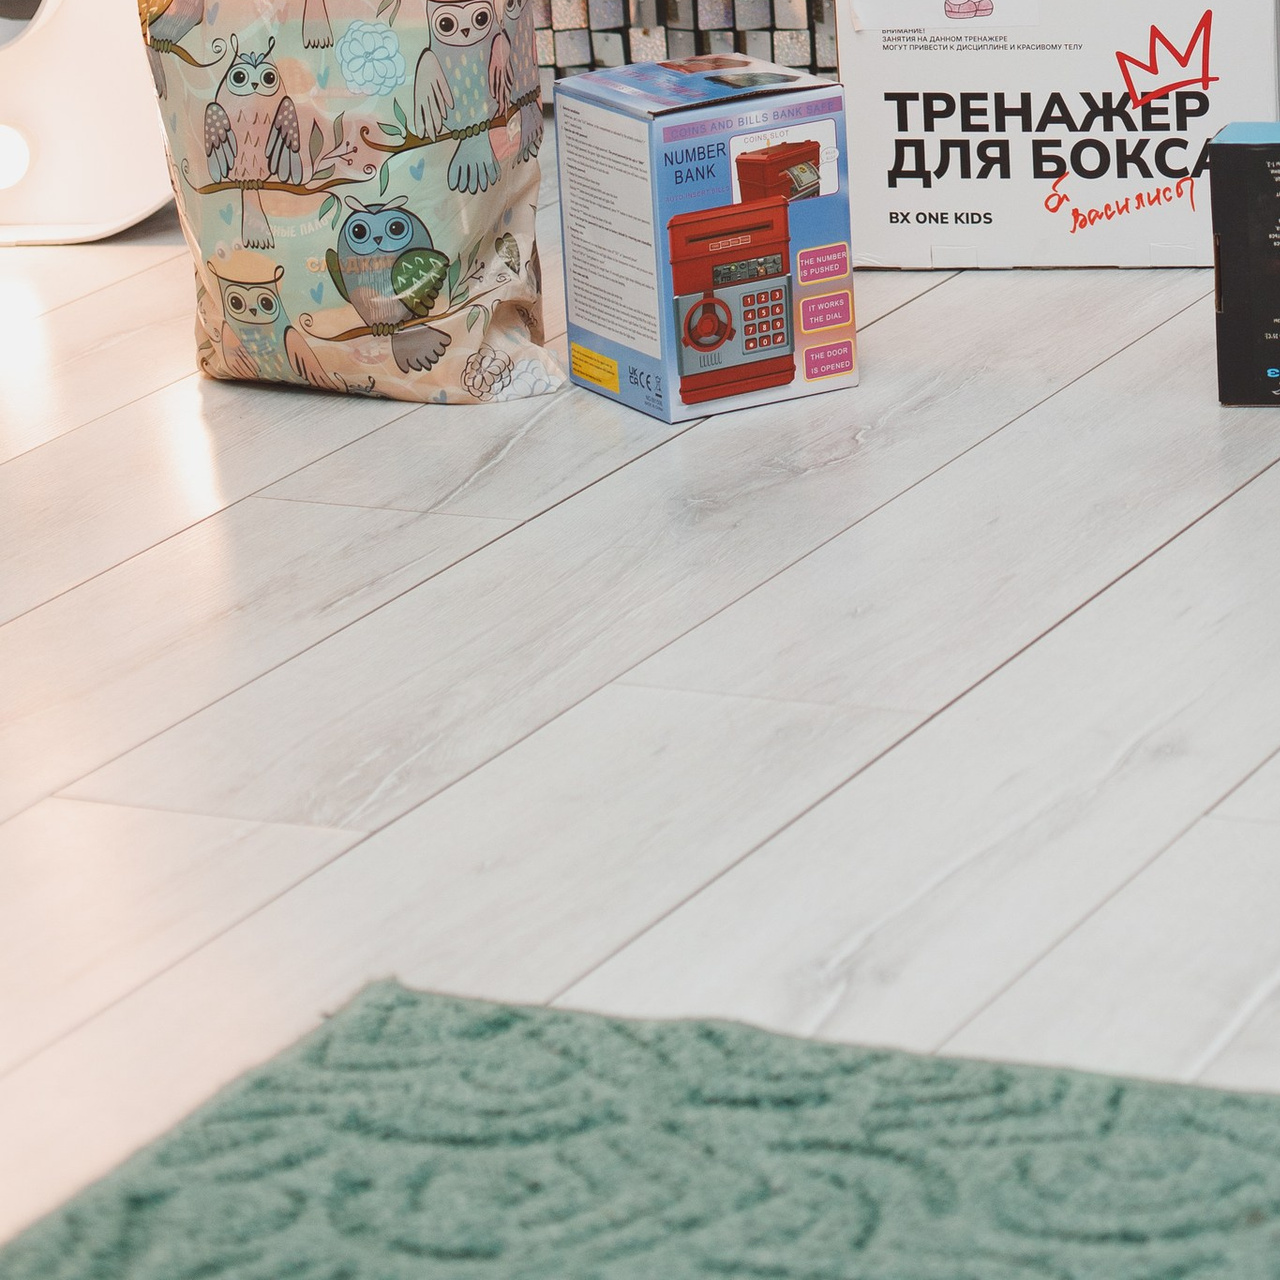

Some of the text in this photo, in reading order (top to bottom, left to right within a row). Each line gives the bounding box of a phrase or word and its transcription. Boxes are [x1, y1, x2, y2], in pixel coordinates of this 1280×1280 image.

[884, 91, 1209, 132] ТРЕНАЖЕР
[671, 102, 834, 138] COINS AND BILLS BANK SAFE
[744, 130, 789, 144] COINS SLOT
[664, 142, 726, 166] NUMBER
[887, 139, 1011, 188] ДЛЯ
[675, 163, 716, 184] BANK
[889, 212, 993, 224] BX ONE KIDS
[800, 251, 847, 266] THE NUMBER
[810, 264, 839, 275] PUSHED
[817, 299, 844, 310] WORKS
[826, 312, 842, 321] DIAL
[810, 347, 848, 360] THE DOOR
[820, 360, 850, 372] OPENED
